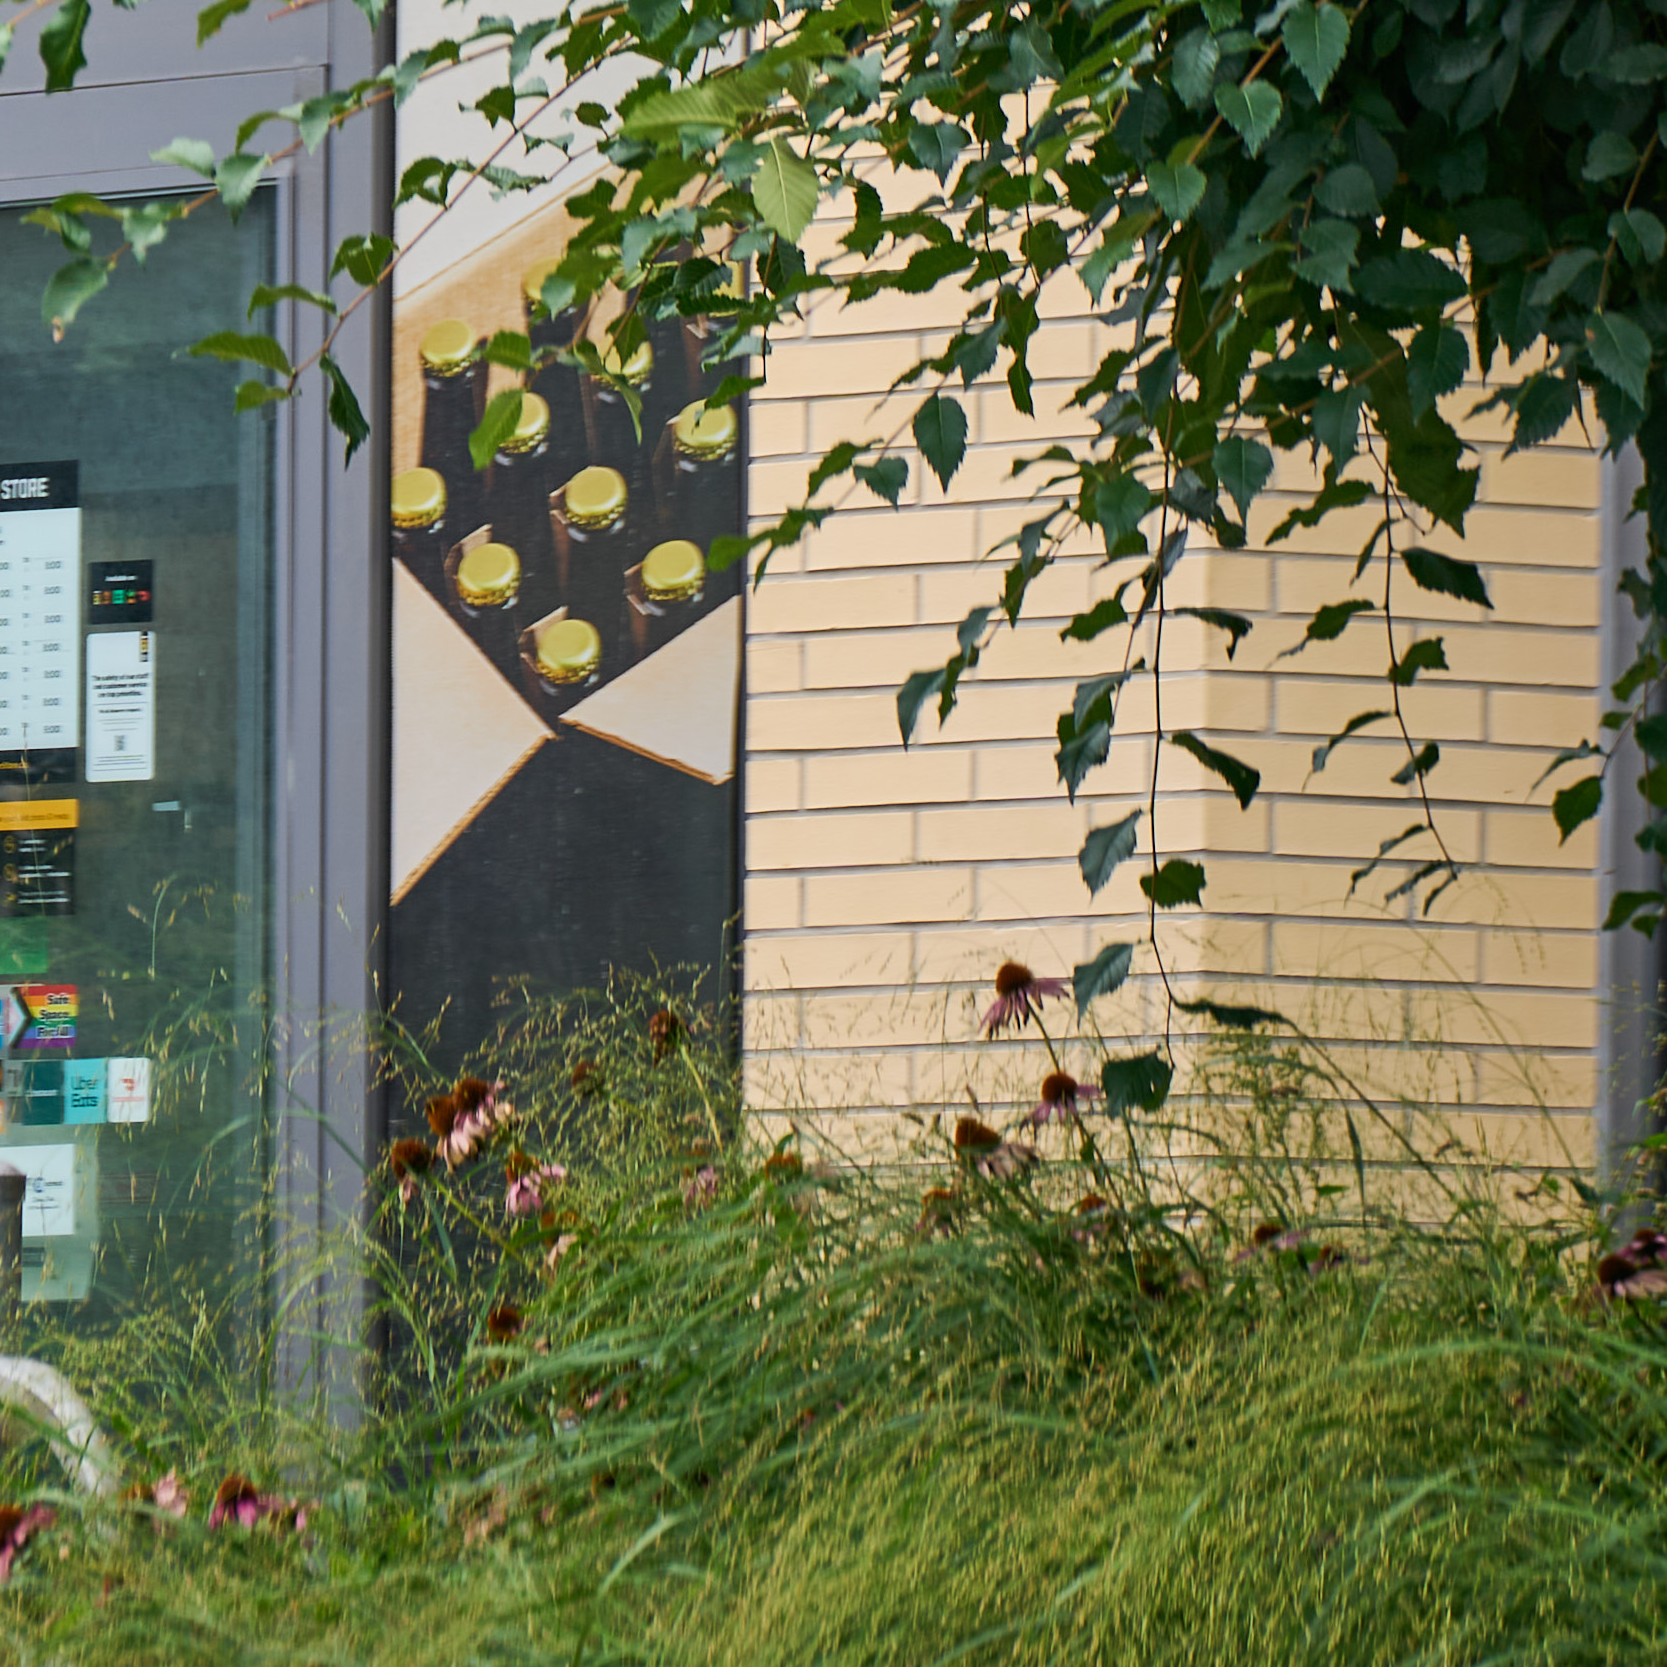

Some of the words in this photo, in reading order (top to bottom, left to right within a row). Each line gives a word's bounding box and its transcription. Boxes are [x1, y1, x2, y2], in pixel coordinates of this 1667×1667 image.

[0, 477, 50, 500] STORE
[46, 993, 69, 1005] Safe
[40, 1009, 69, 1022] Space
[37, 1026, 55, 1037] For
[71, 1075, 98, 1089] Uber
[71, 1092, 99, 1108] Eats
